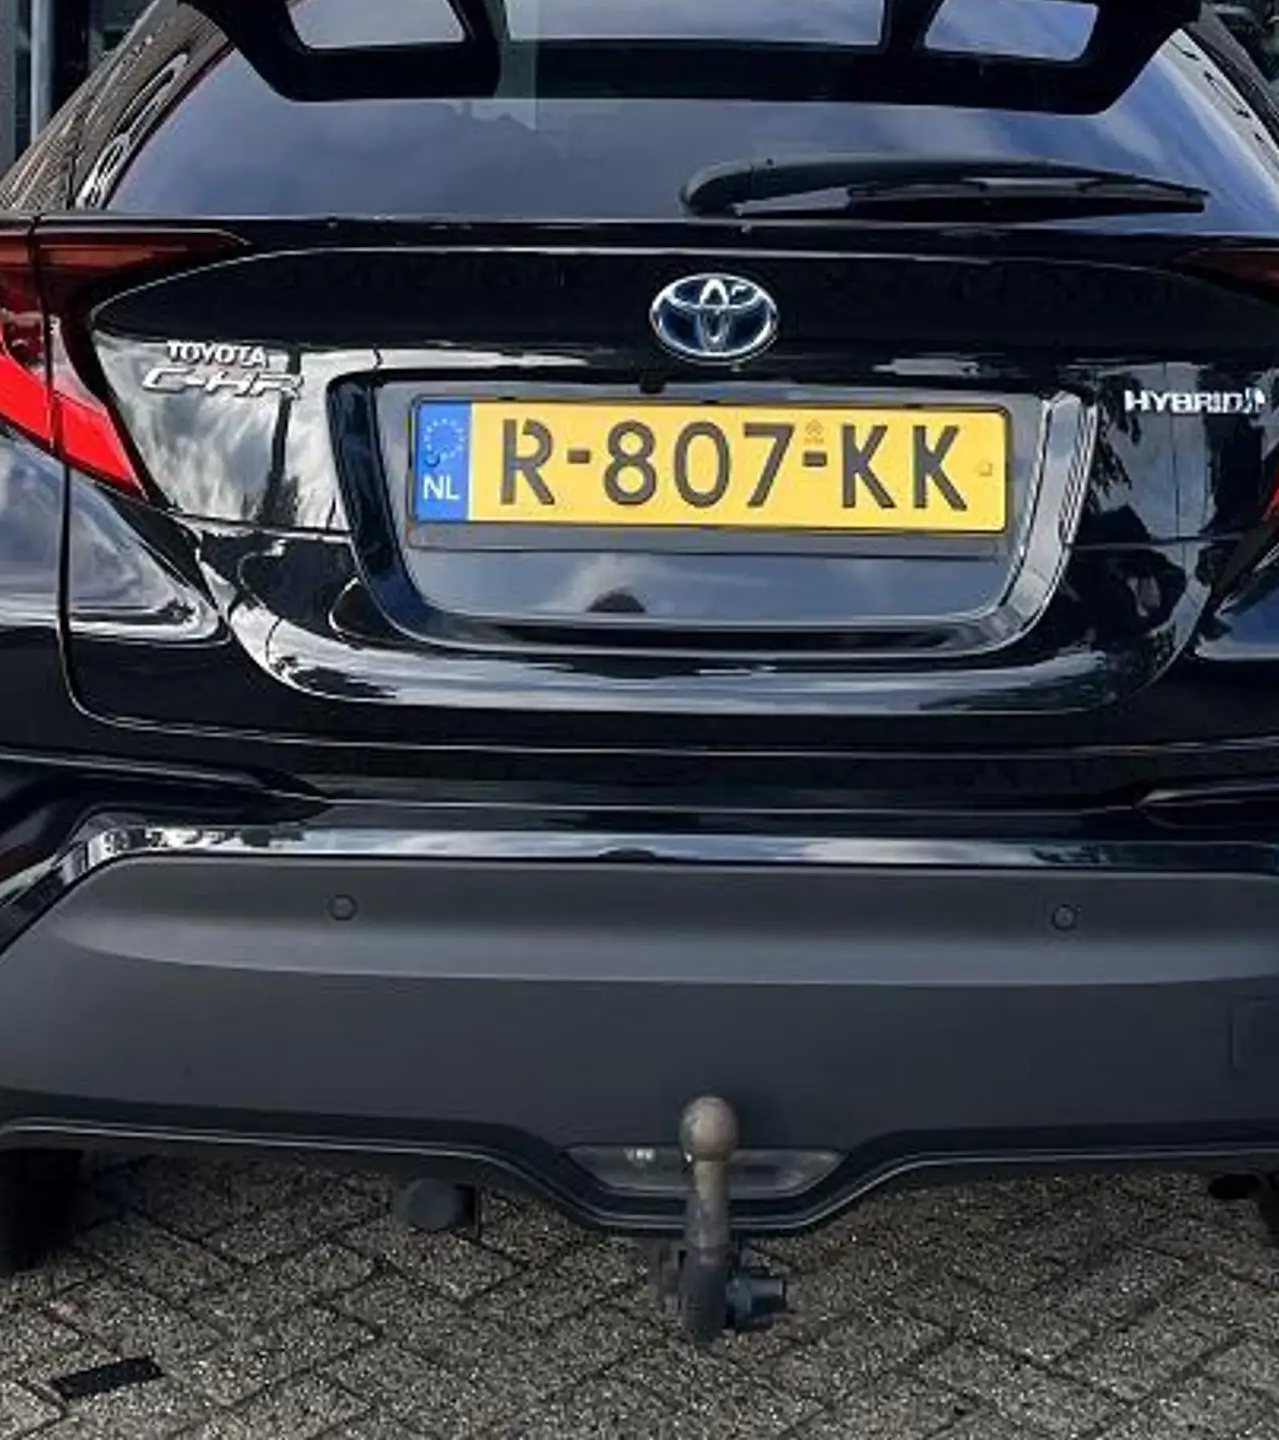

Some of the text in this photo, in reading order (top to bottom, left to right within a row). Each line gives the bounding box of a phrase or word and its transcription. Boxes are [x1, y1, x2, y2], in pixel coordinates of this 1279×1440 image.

[167, 339, 268, 369] TOYOTA
[142, 367, 305, 399] C-HR
[1124, 389, 1244, 414] HYBRID
[499, 417, 969, 513] R-807-KK
[423, 474, 461, 502] NL
